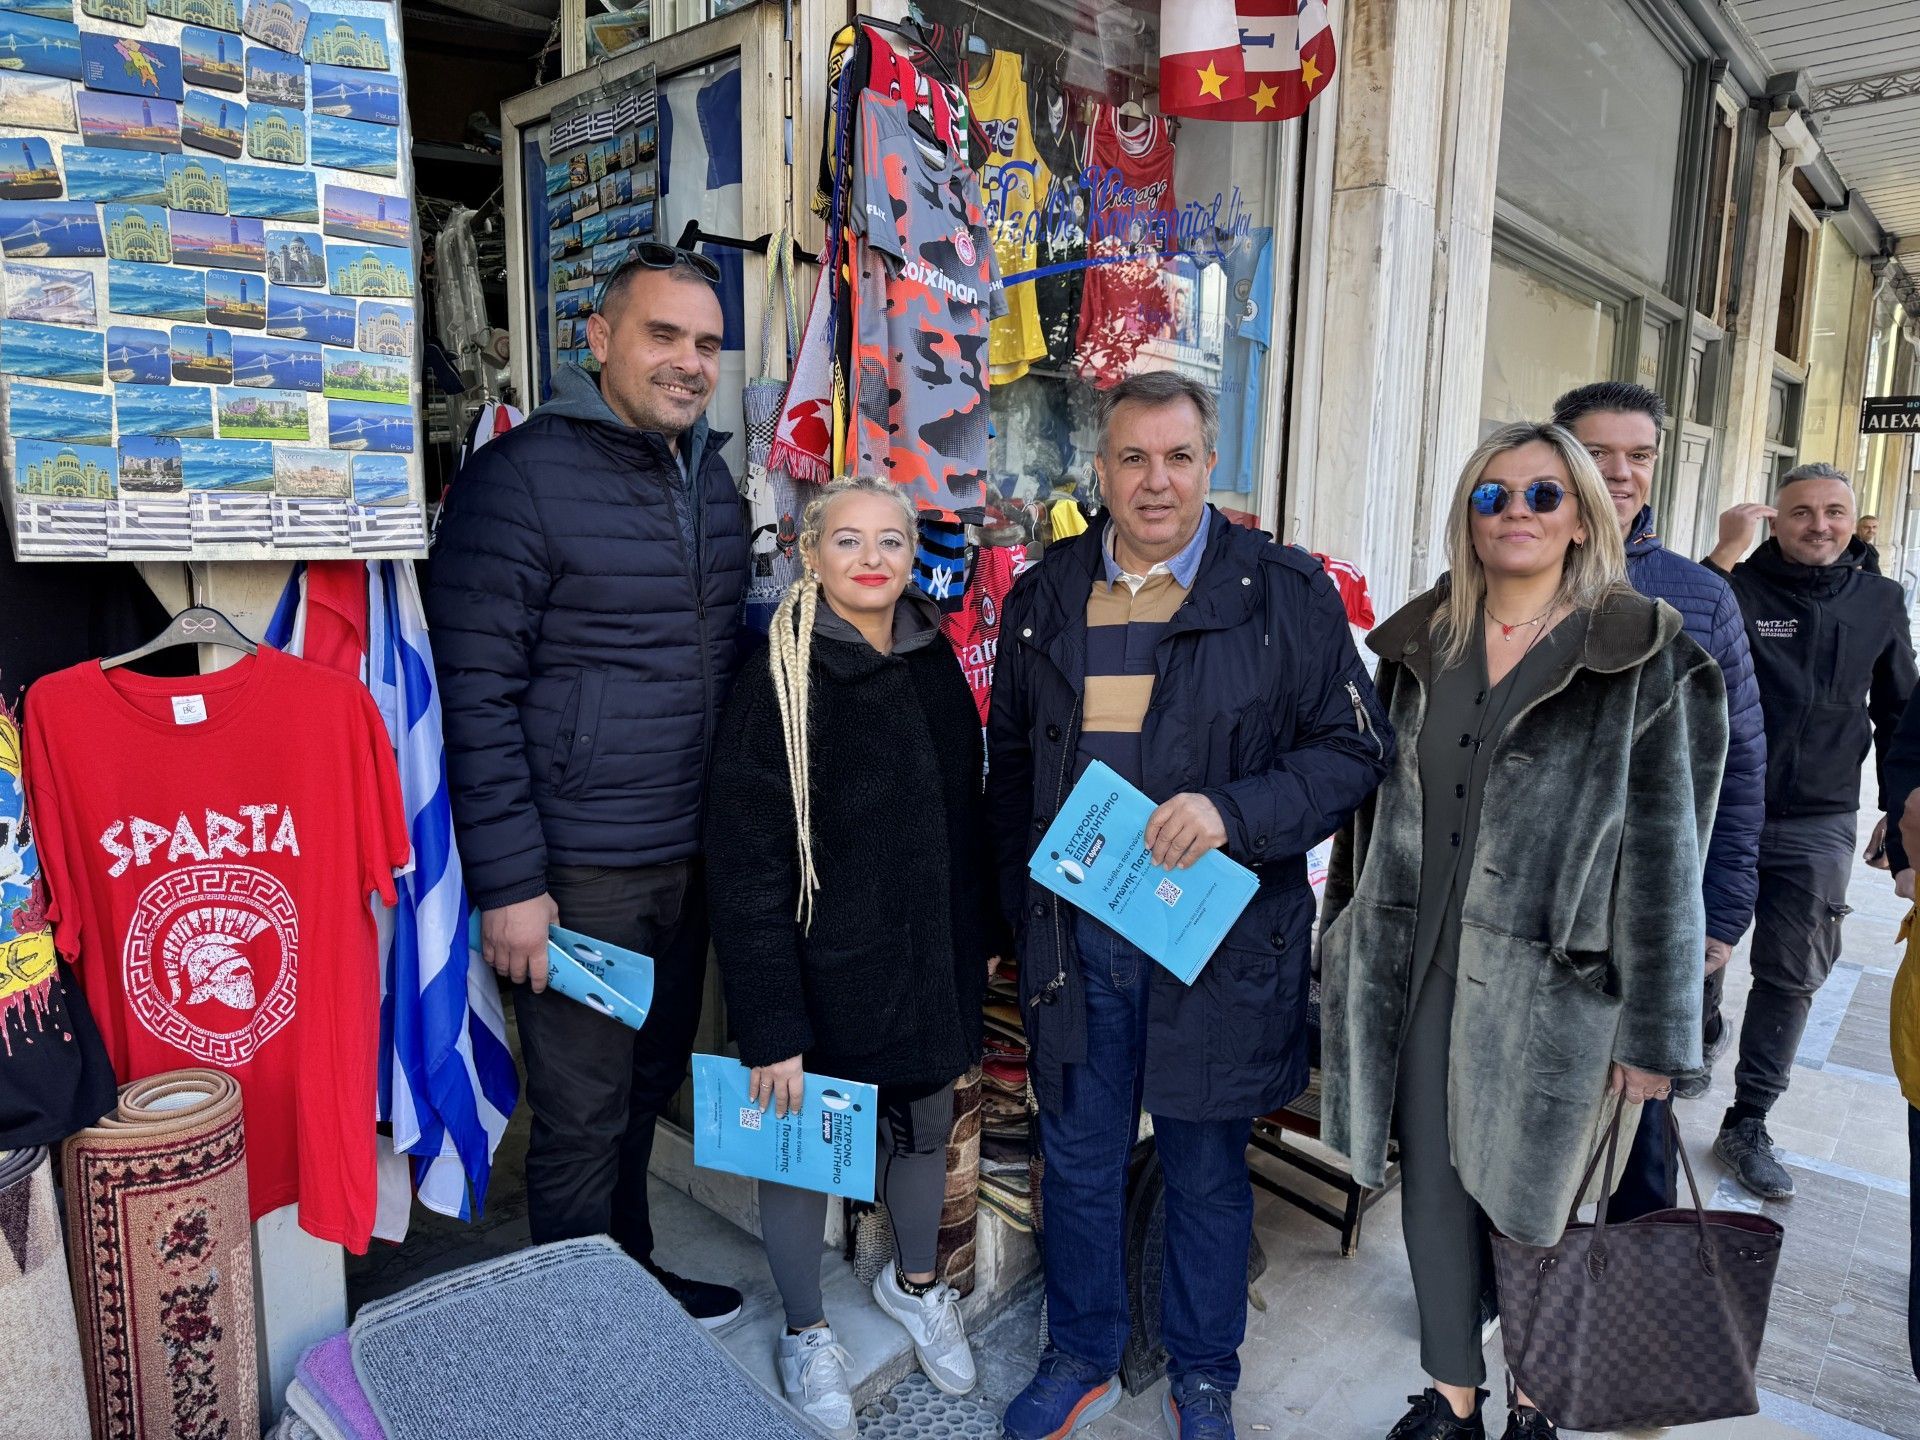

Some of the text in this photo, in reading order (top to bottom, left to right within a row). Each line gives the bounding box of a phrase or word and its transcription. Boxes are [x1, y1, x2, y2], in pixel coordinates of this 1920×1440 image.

[900, 248, 978, 305] toiximan
[98, 803, 301, 878] SPARTA
[1064, 804, 1099, 856] ΣΥΓΧΡΟΝΟ
[1072, 791, 1119, 861] ΕΠΙΜΕΛΗΤΗΡΙΟ
[1108, 872, 1137, 911] Αντώνης
[1130, 848, 1151, 872] Ποτα
[832, 1112, 842, 1185] ΕΠΙΜΕΛΗΤΗΡΙΟ
[843, 1114, 853, 1167] ΣΥΓΧΡΟΝΟ
